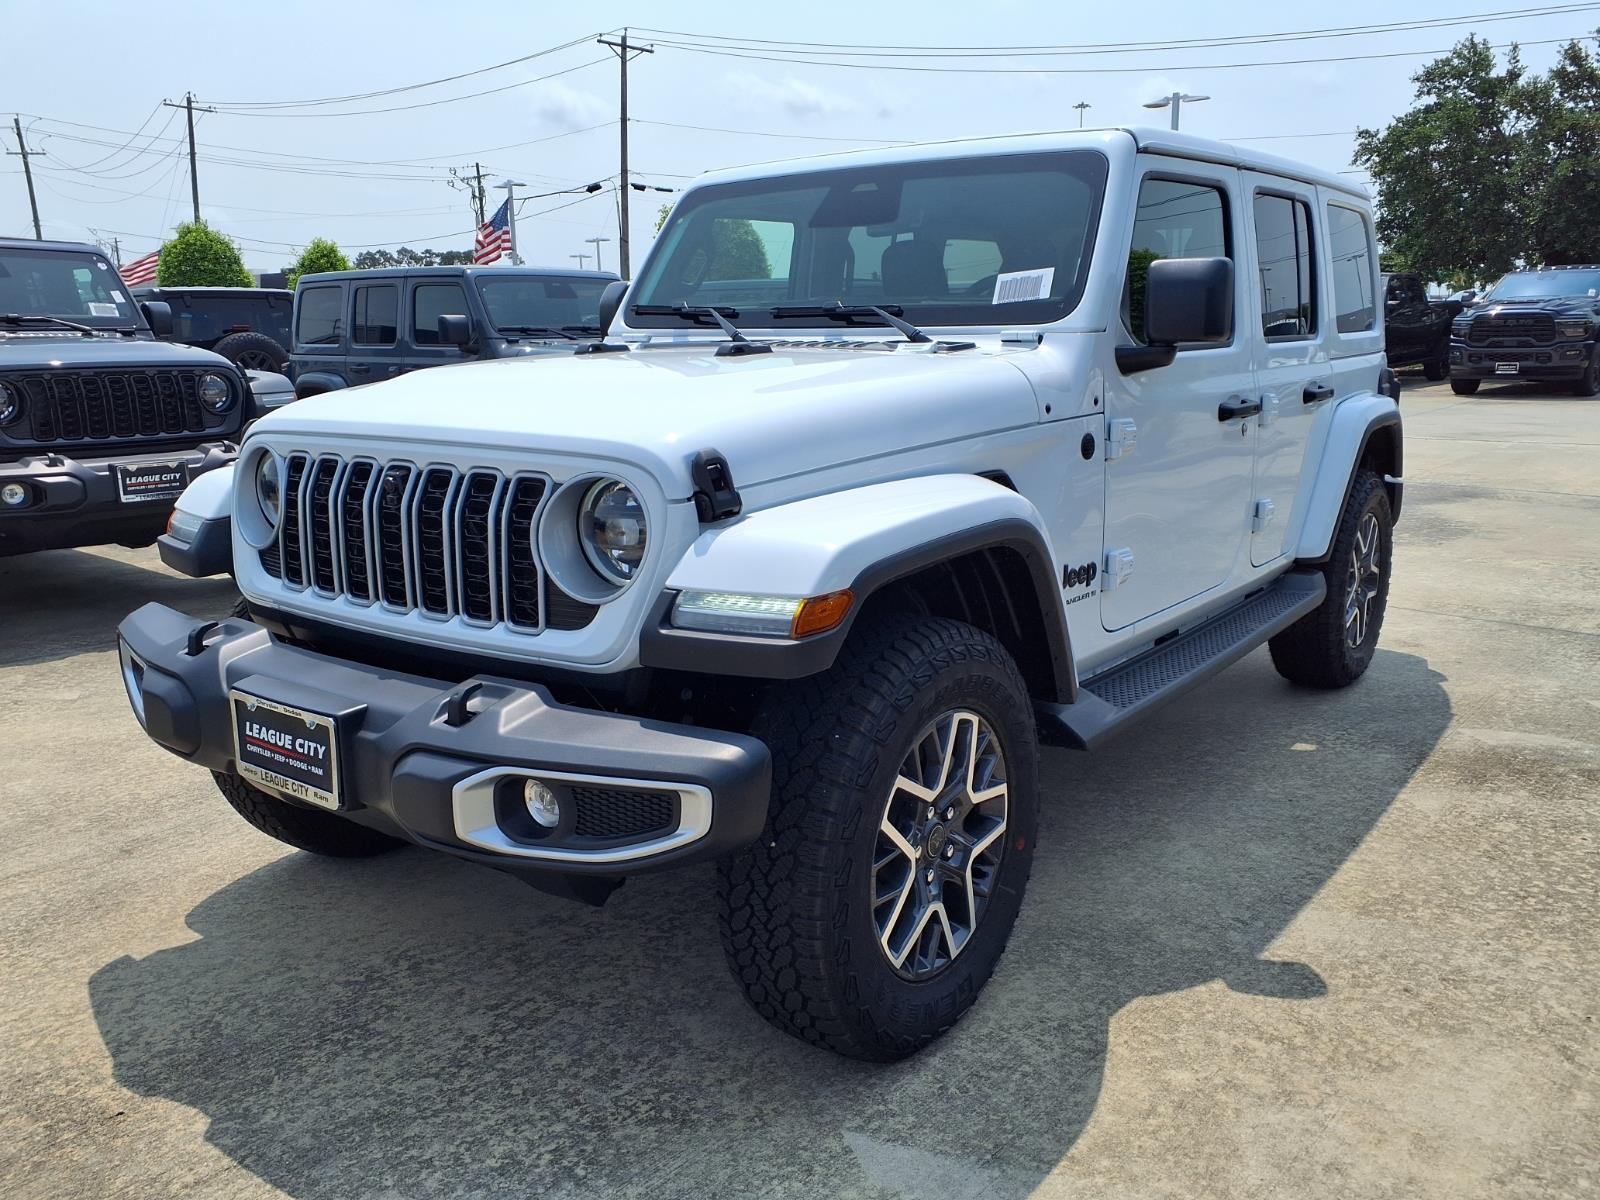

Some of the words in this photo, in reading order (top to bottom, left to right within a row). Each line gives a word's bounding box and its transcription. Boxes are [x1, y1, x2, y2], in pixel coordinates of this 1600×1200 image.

[126, 475, 160, 484] LEAGUE
[1063, 561, 1097, 589] Jeep
[245, 721, 293, 750] LEAGUE
[295, 738, 326, 760] CITY
[247, 744, 272, 757] CHRYSLER
[274, 753, 286, 763] JEEP
[289, 759, 308, 770] DODGE
[311, 765, 324, 776] RAM
[260, 770, 290, 791] LEAGUE
[291, 782, 309, 797] CITY
[313, 791, 329, 803] Ram
